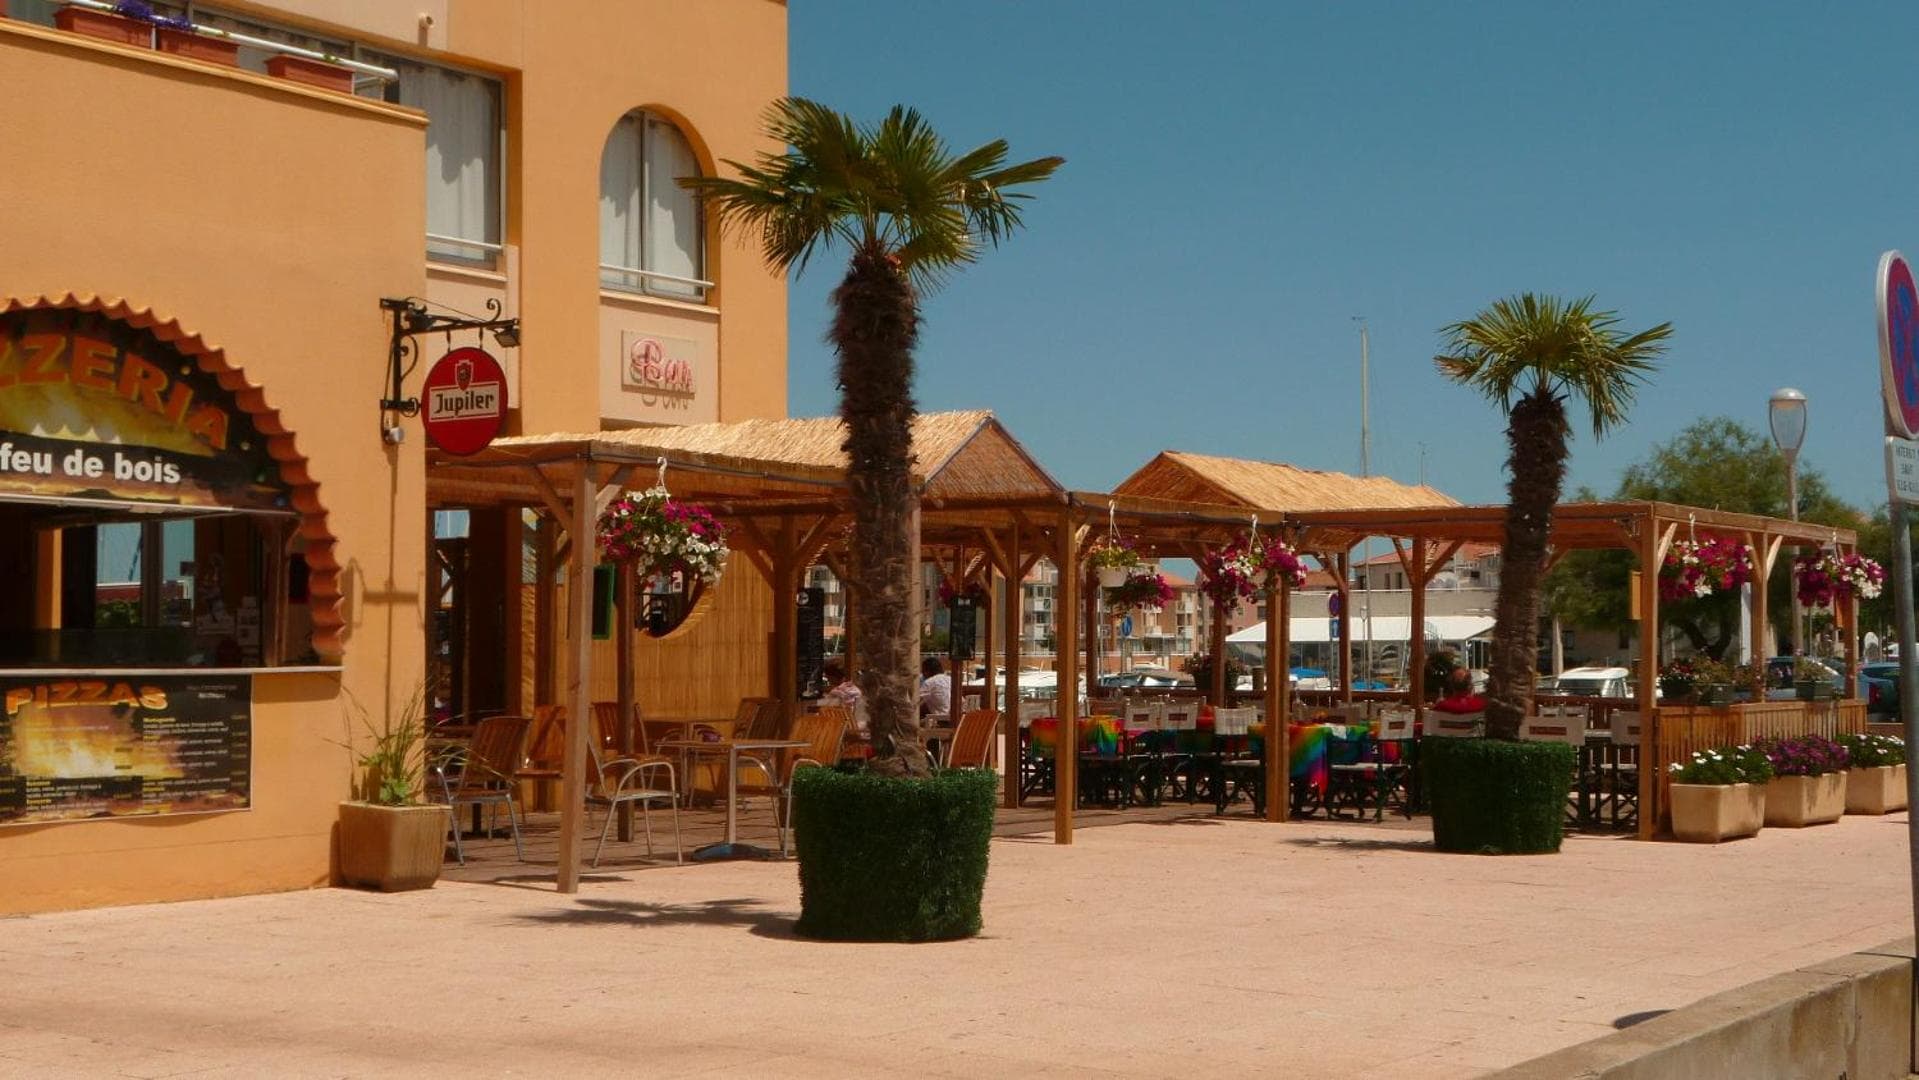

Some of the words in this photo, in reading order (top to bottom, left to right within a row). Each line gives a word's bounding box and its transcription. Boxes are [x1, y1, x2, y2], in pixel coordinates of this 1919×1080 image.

[433, 390, 495, 417] Jupiler
[0, 442, 53, 474] feu
[63, 449, 104, 478] de
[114, 452, 182, 484] bois
[6, 679, 169, 715] PIZZAS
